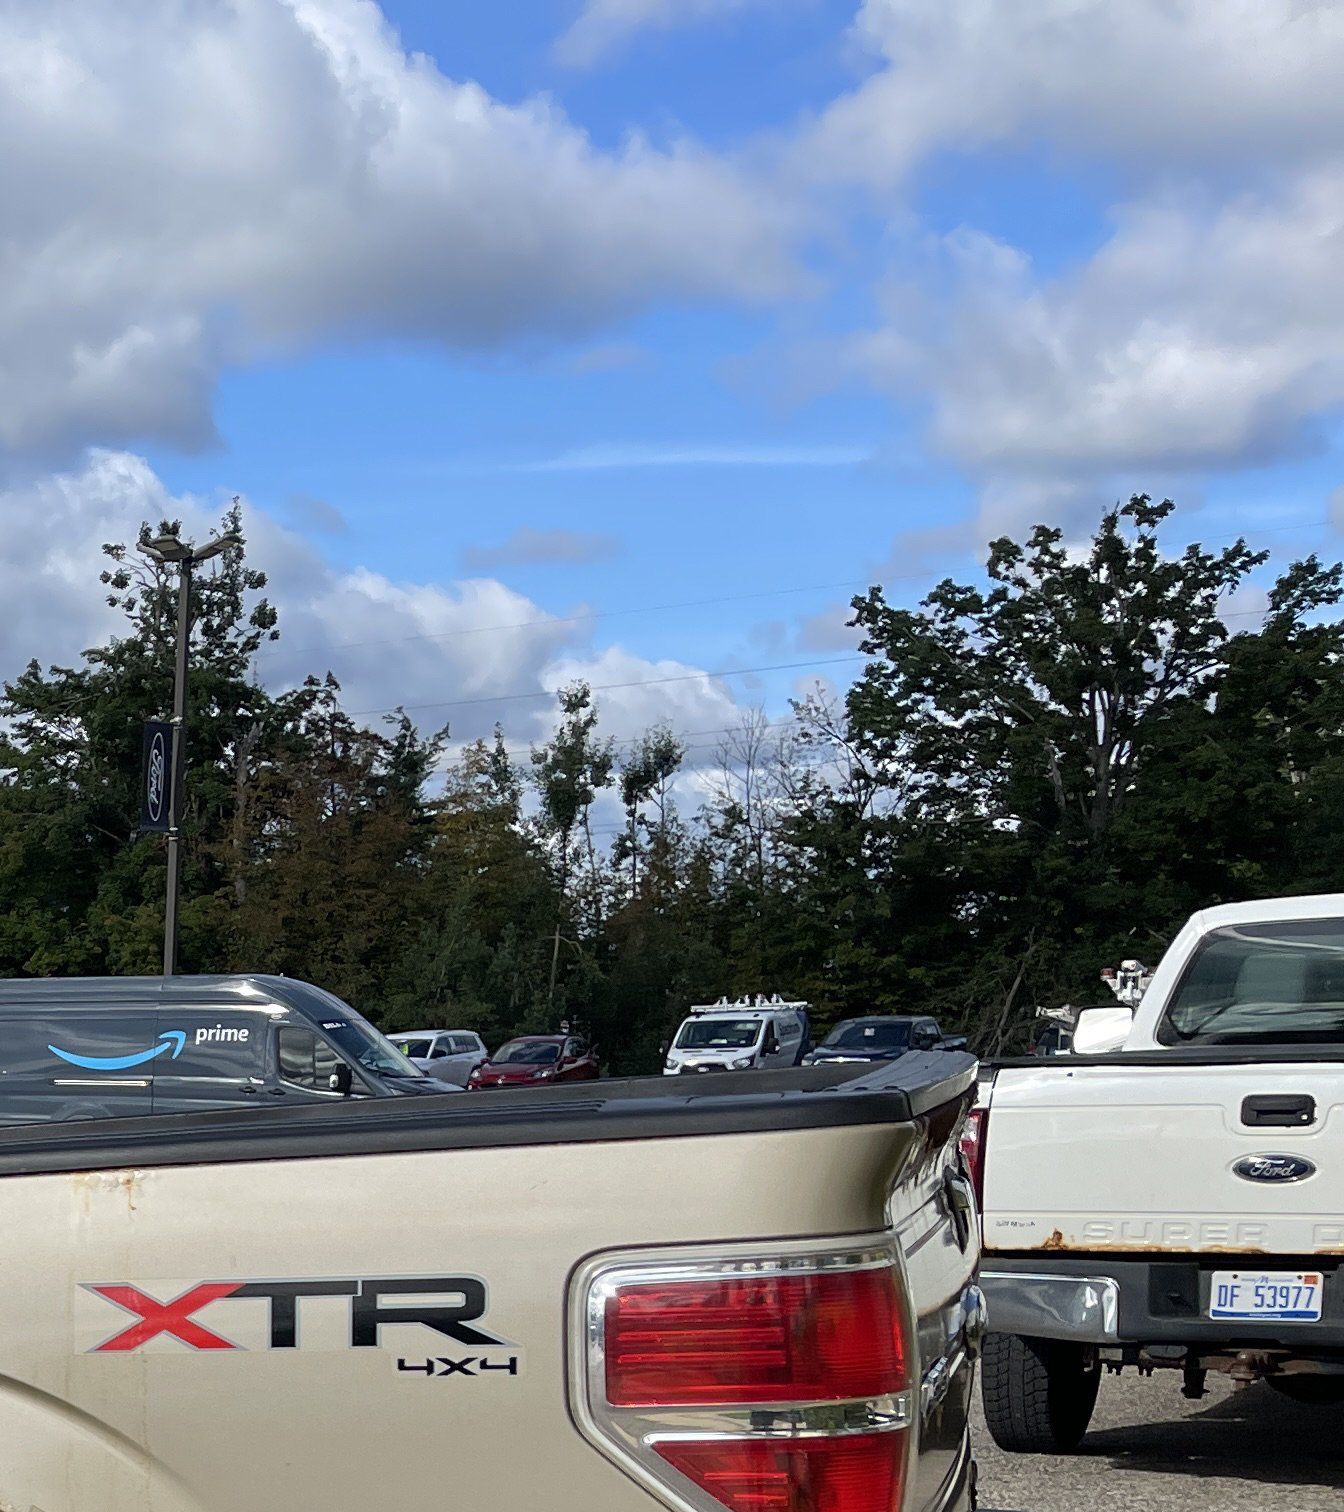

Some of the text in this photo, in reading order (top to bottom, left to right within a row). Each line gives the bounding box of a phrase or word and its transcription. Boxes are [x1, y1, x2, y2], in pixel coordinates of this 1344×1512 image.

[195, 1024, 249, 1045] prime
[1217, 1284, 1315, 1309] DF 53977
[79, 1273, 519, 1352] XTR
